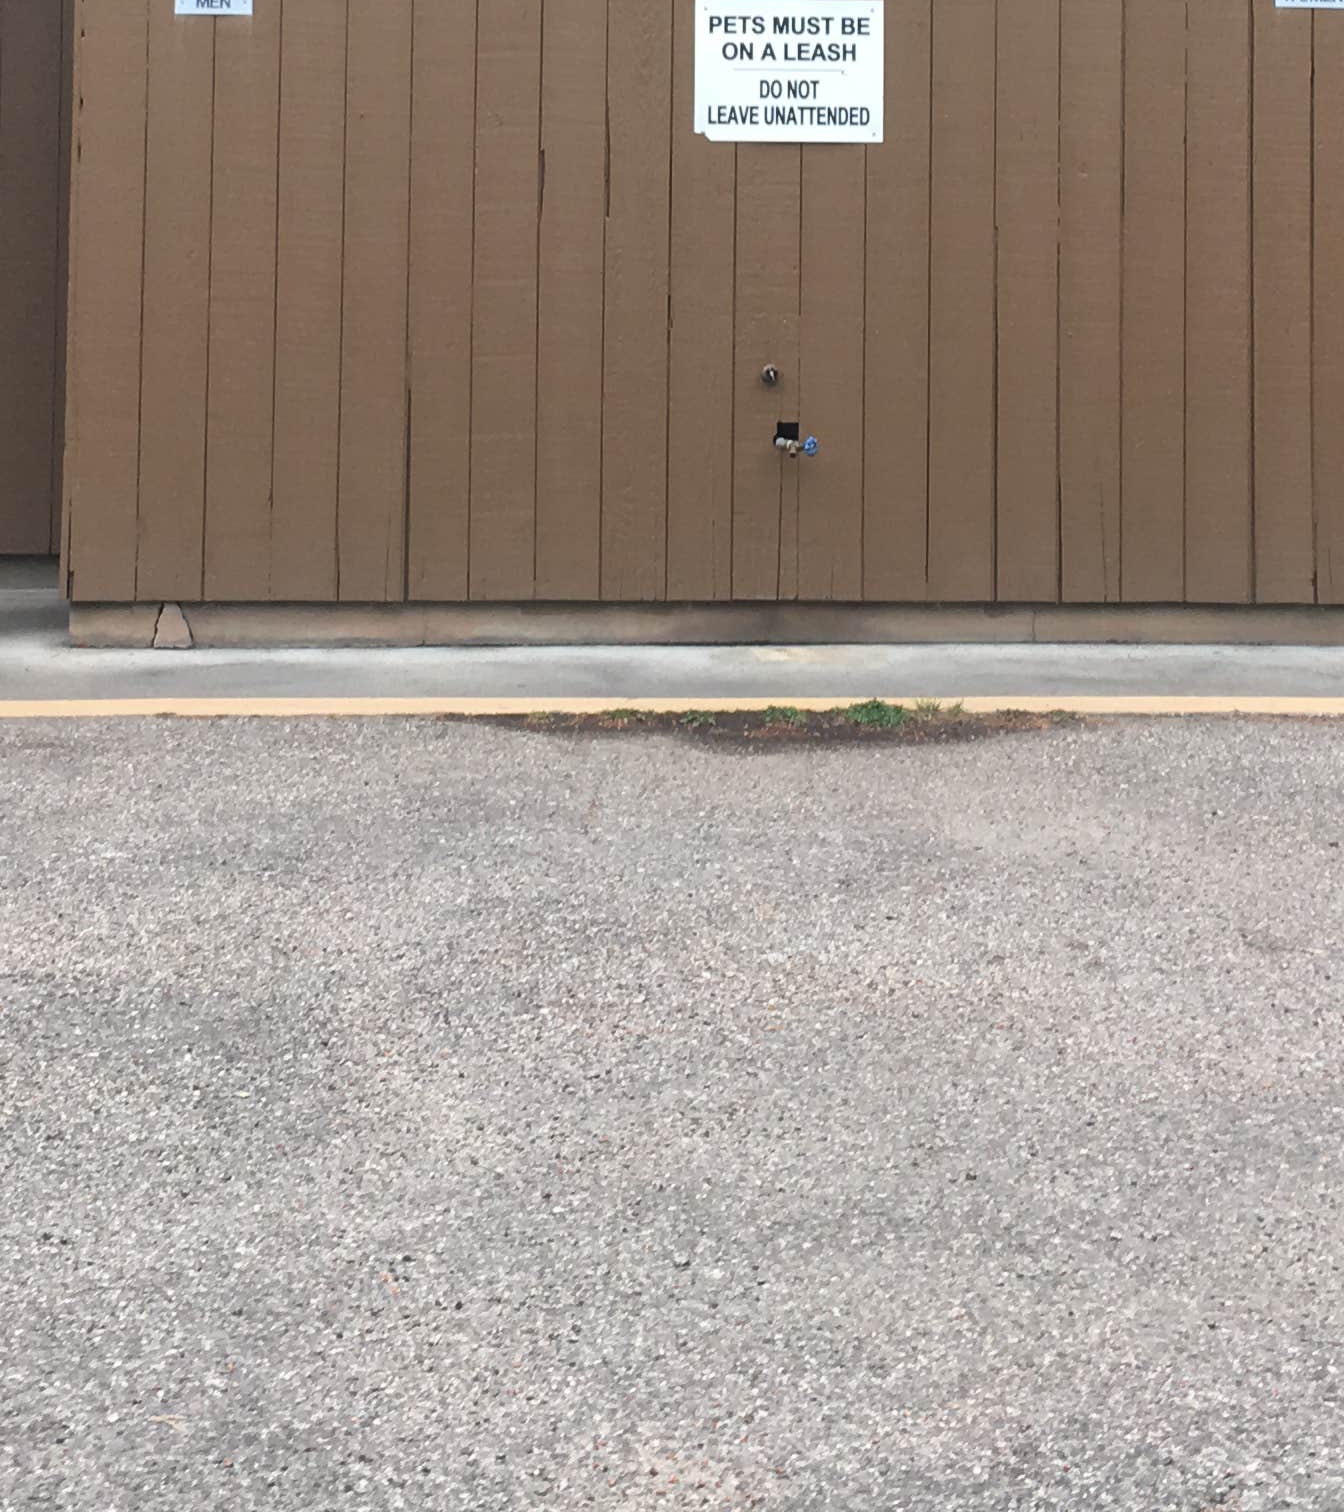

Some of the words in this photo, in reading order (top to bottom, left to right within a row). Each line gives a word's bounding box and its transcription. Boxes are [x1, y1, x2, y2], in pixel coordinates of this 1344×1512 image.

[708, 16, 765, 34] PETS
[773, 17, 834, 35] MUST
[841, 17, 871, 36] BE
[722, 42, 754, 61] ON
[761, 42, 777, 61] A
[784, 43, 857, 62] LEASH
[759, 80, 782, 99] DO
[787, 80, 820, 99] NOT
[708, 105, 759, 125] LEAVE
[764, 106, 870, 126] UNATTENDED
